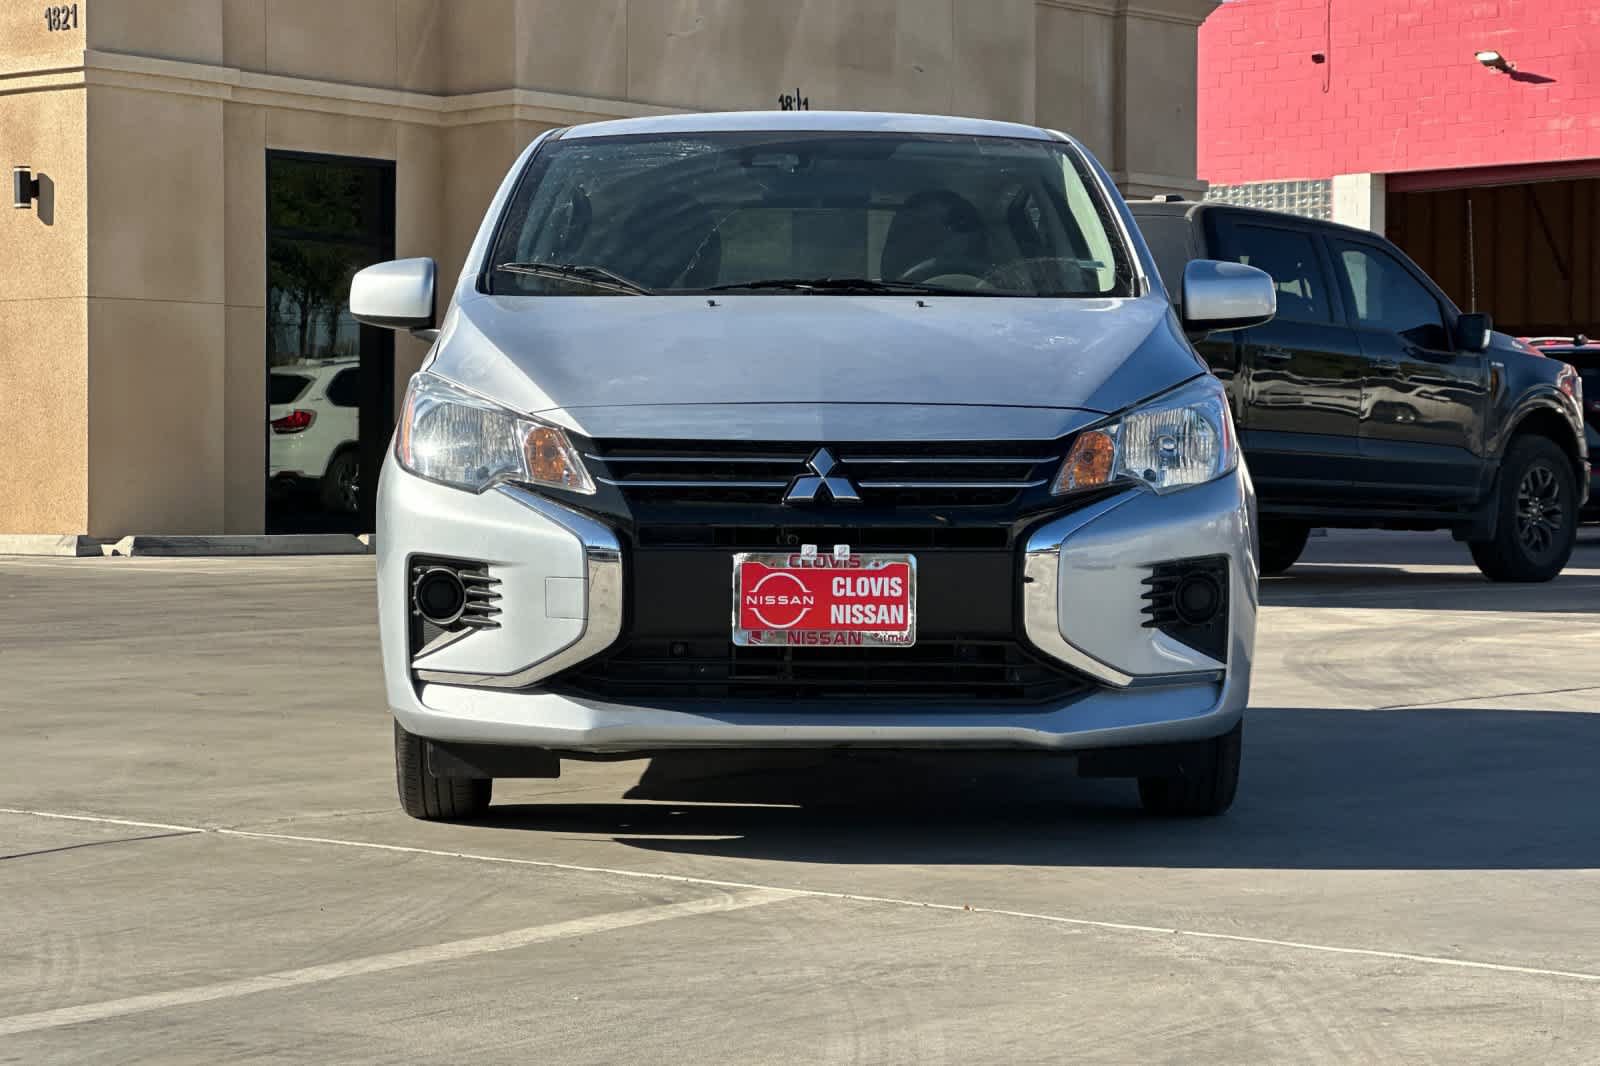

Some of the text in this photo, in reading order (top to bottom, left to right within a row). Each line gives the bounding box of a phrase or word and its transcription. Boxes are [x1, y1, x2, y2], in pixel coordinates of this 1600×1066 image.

[44, 4, 78, 32] 1821
[831, 576, 903, 597] CLOVIS
[746, 595, 815, 606] NISSAN
[830, 604, 904, 625] NISSAN
[787, 630, 863, 646] NISSAN
